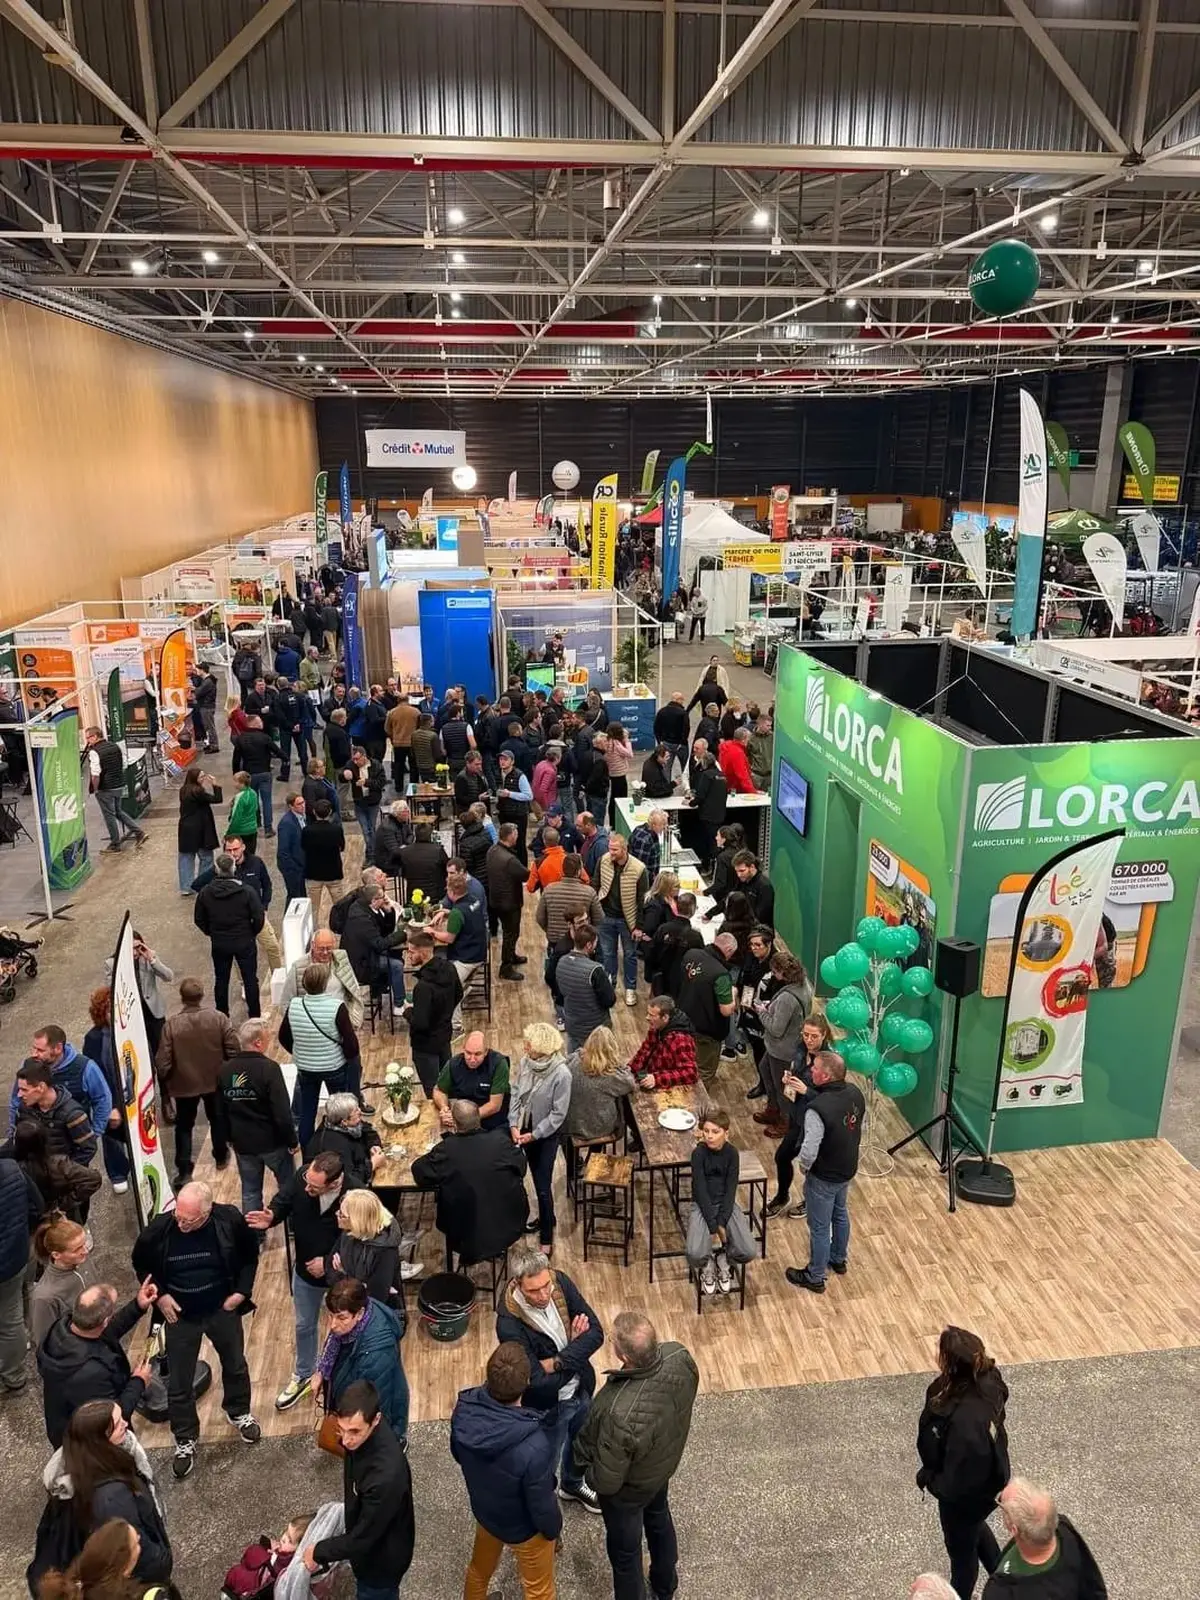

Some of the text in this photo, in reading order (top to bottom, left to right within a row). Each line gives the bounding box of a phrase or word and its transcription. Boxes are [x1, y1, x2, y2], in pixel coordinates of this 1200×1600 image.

[382, 443, 455, 454] Crédit Mutuel
[316, 487, 327, 540] SOBAC
[823, 693, 903, 795] LORCA
[1028, 780, 1200, 829] LORCA
[972, 837, 1025, 848] AGRICULTURE
[1035, 835, 1063, 845] JARDIN
[1125, 829, 1156, 839] TÉRIAUX
[1156, 828, 1163, 837] &
[1164, 826, 1200, 837] ÉNERGIES
[1114, 862, 1166, 876] 670 000
